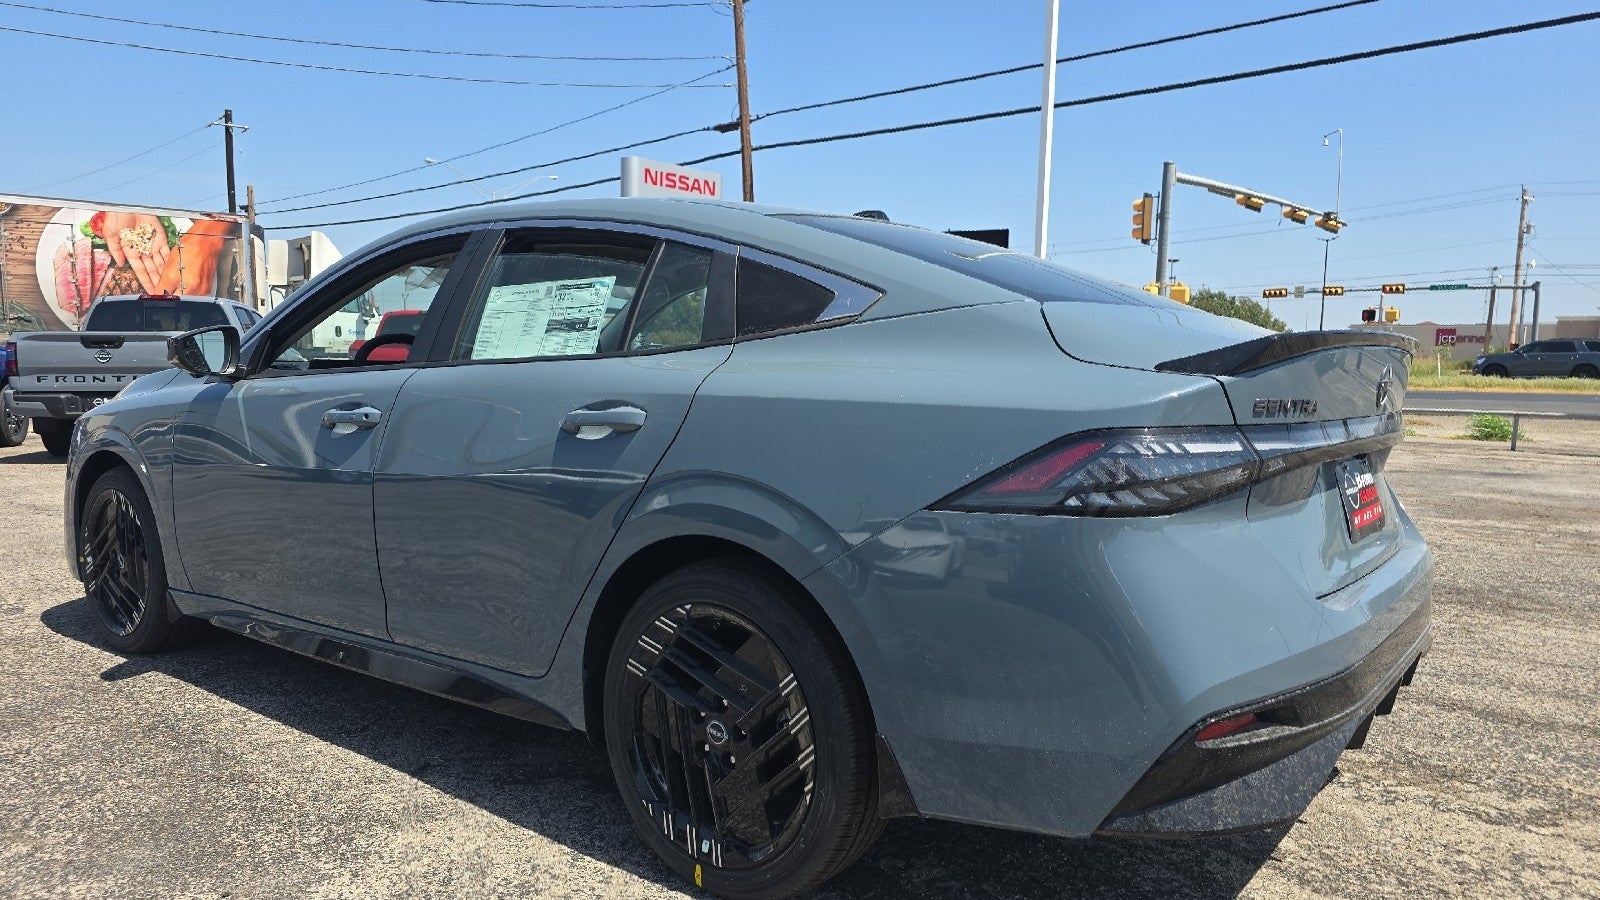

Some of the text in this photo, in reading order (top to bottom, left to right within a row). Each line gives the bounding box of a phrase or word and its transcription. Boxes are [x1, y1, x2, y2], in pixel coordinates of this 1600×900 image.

[644, 168, 716, 196] NISSAN
[1438, 333, 1493, 346] jcpenne
[1252, 398, 1318, 418] SENTRA
